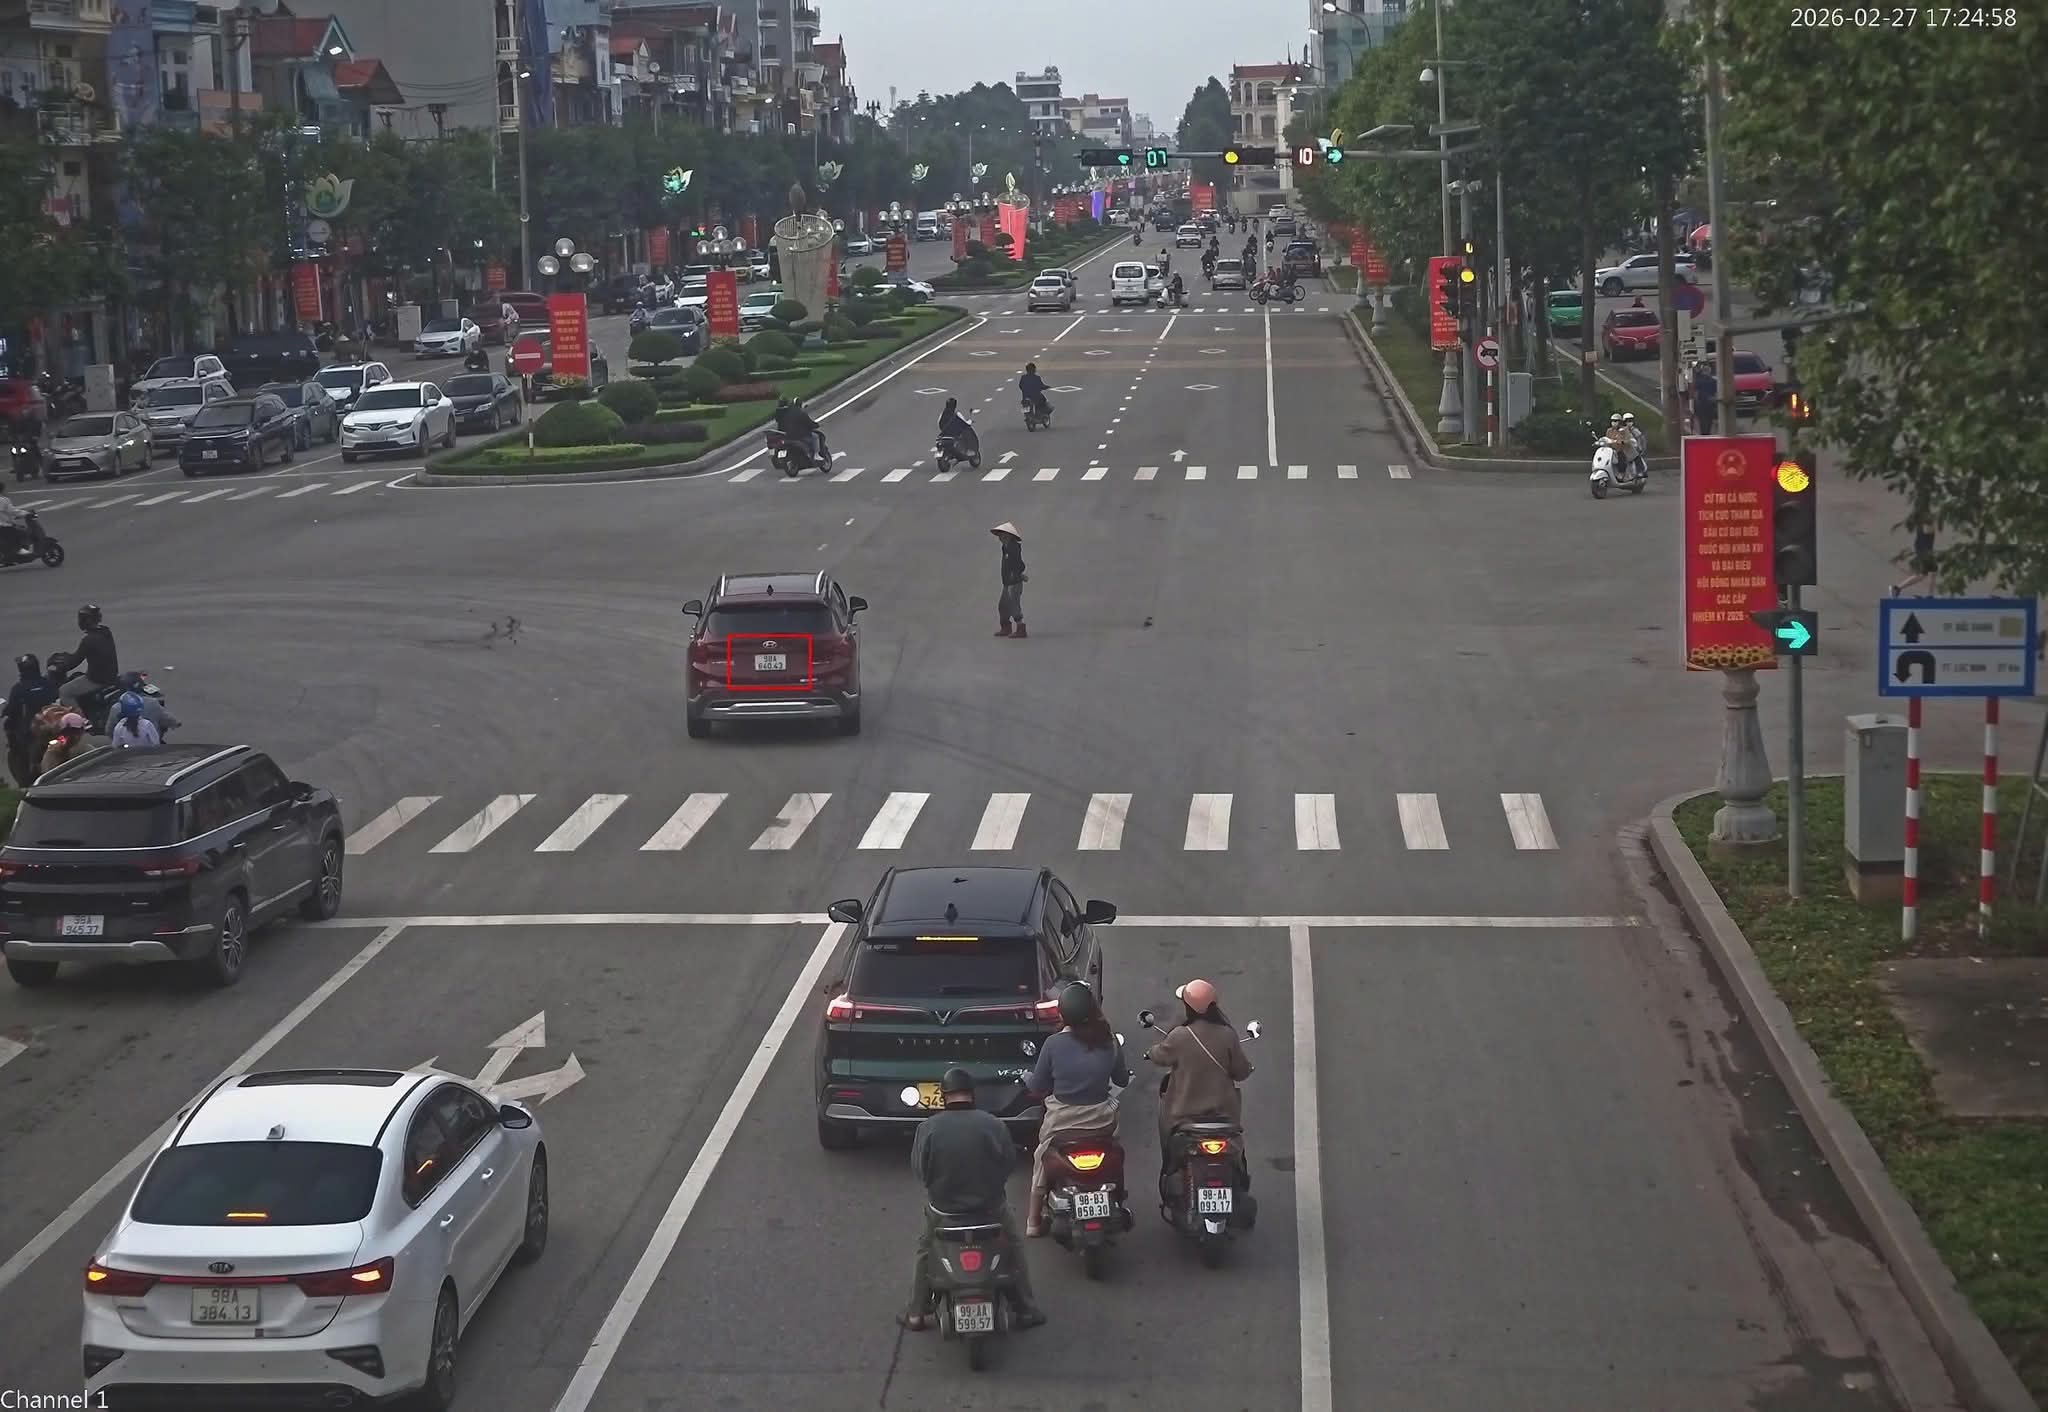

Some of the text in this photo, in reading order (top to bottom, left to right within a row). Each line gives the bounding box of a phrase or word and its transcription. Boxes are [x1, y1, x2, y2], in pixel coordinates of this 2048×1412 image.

[1147, 150, 1167, 166] 07
[1299, 148, 1312, 165] 10
[1202, 1190, 1227, 1200] 98-AA
[1200, 1201, 1230, 1212] 093.17
[211, 1289, 239, 1303] 98A
[199, 1305, 251, 1320] 384.13
